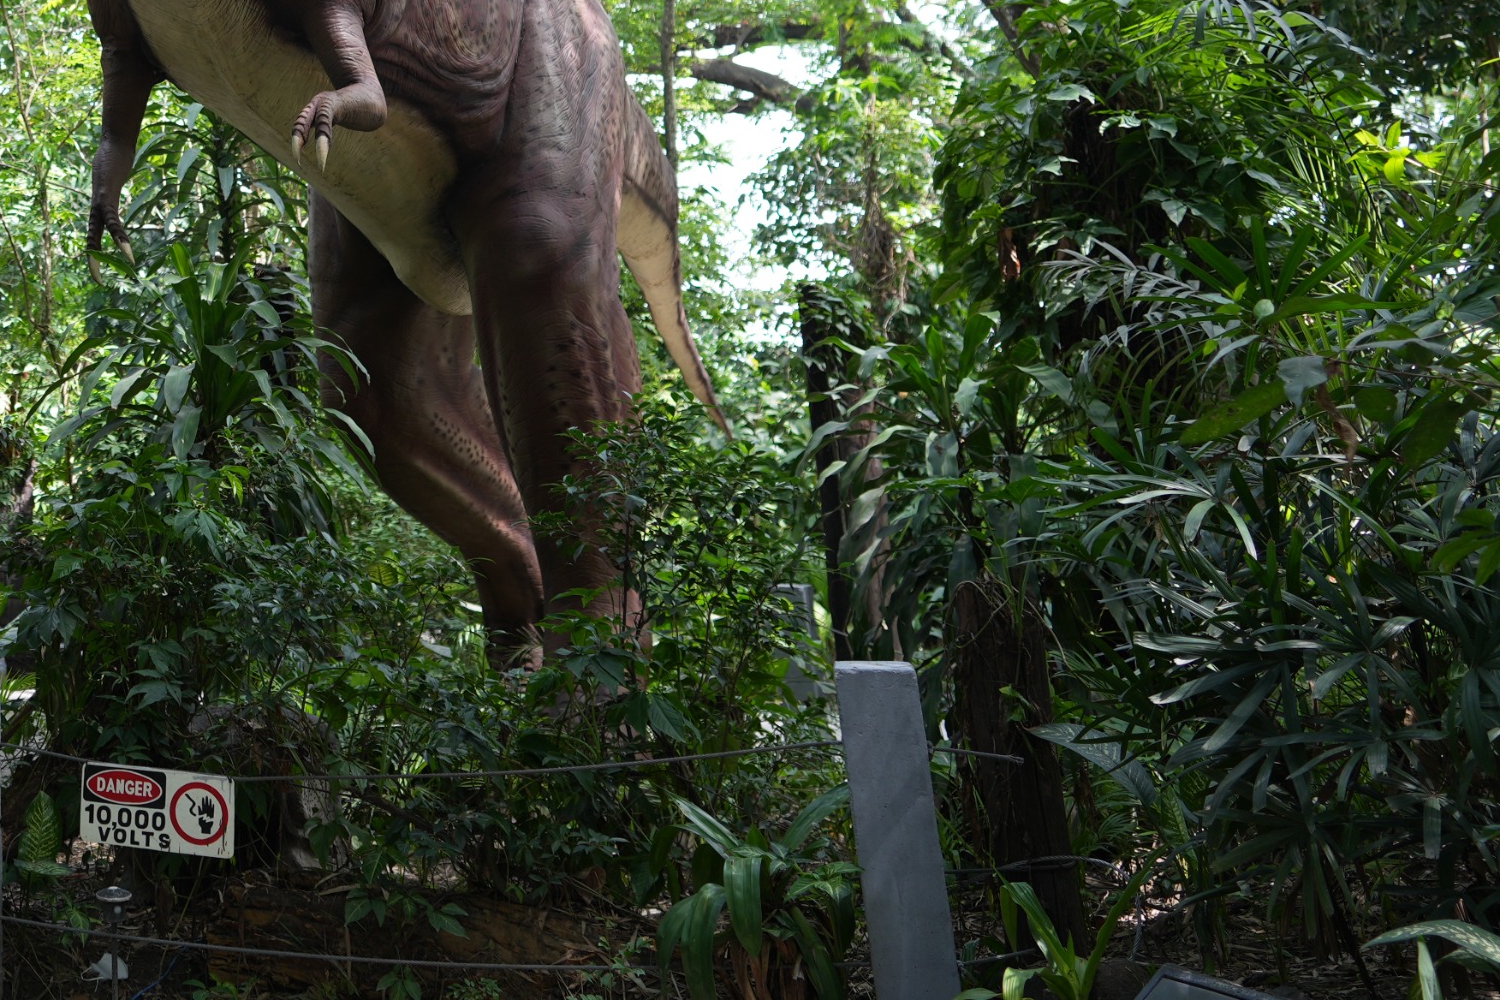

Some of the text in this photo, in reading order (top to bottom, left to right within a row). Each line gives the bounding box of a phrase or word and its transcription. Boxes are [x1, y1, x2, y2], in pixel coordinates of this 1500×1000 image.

[96, 776, 153, 798] DANGER
[85, 804, 166, 831] 10,000
[98, 826, 171, 848] VOLTS
